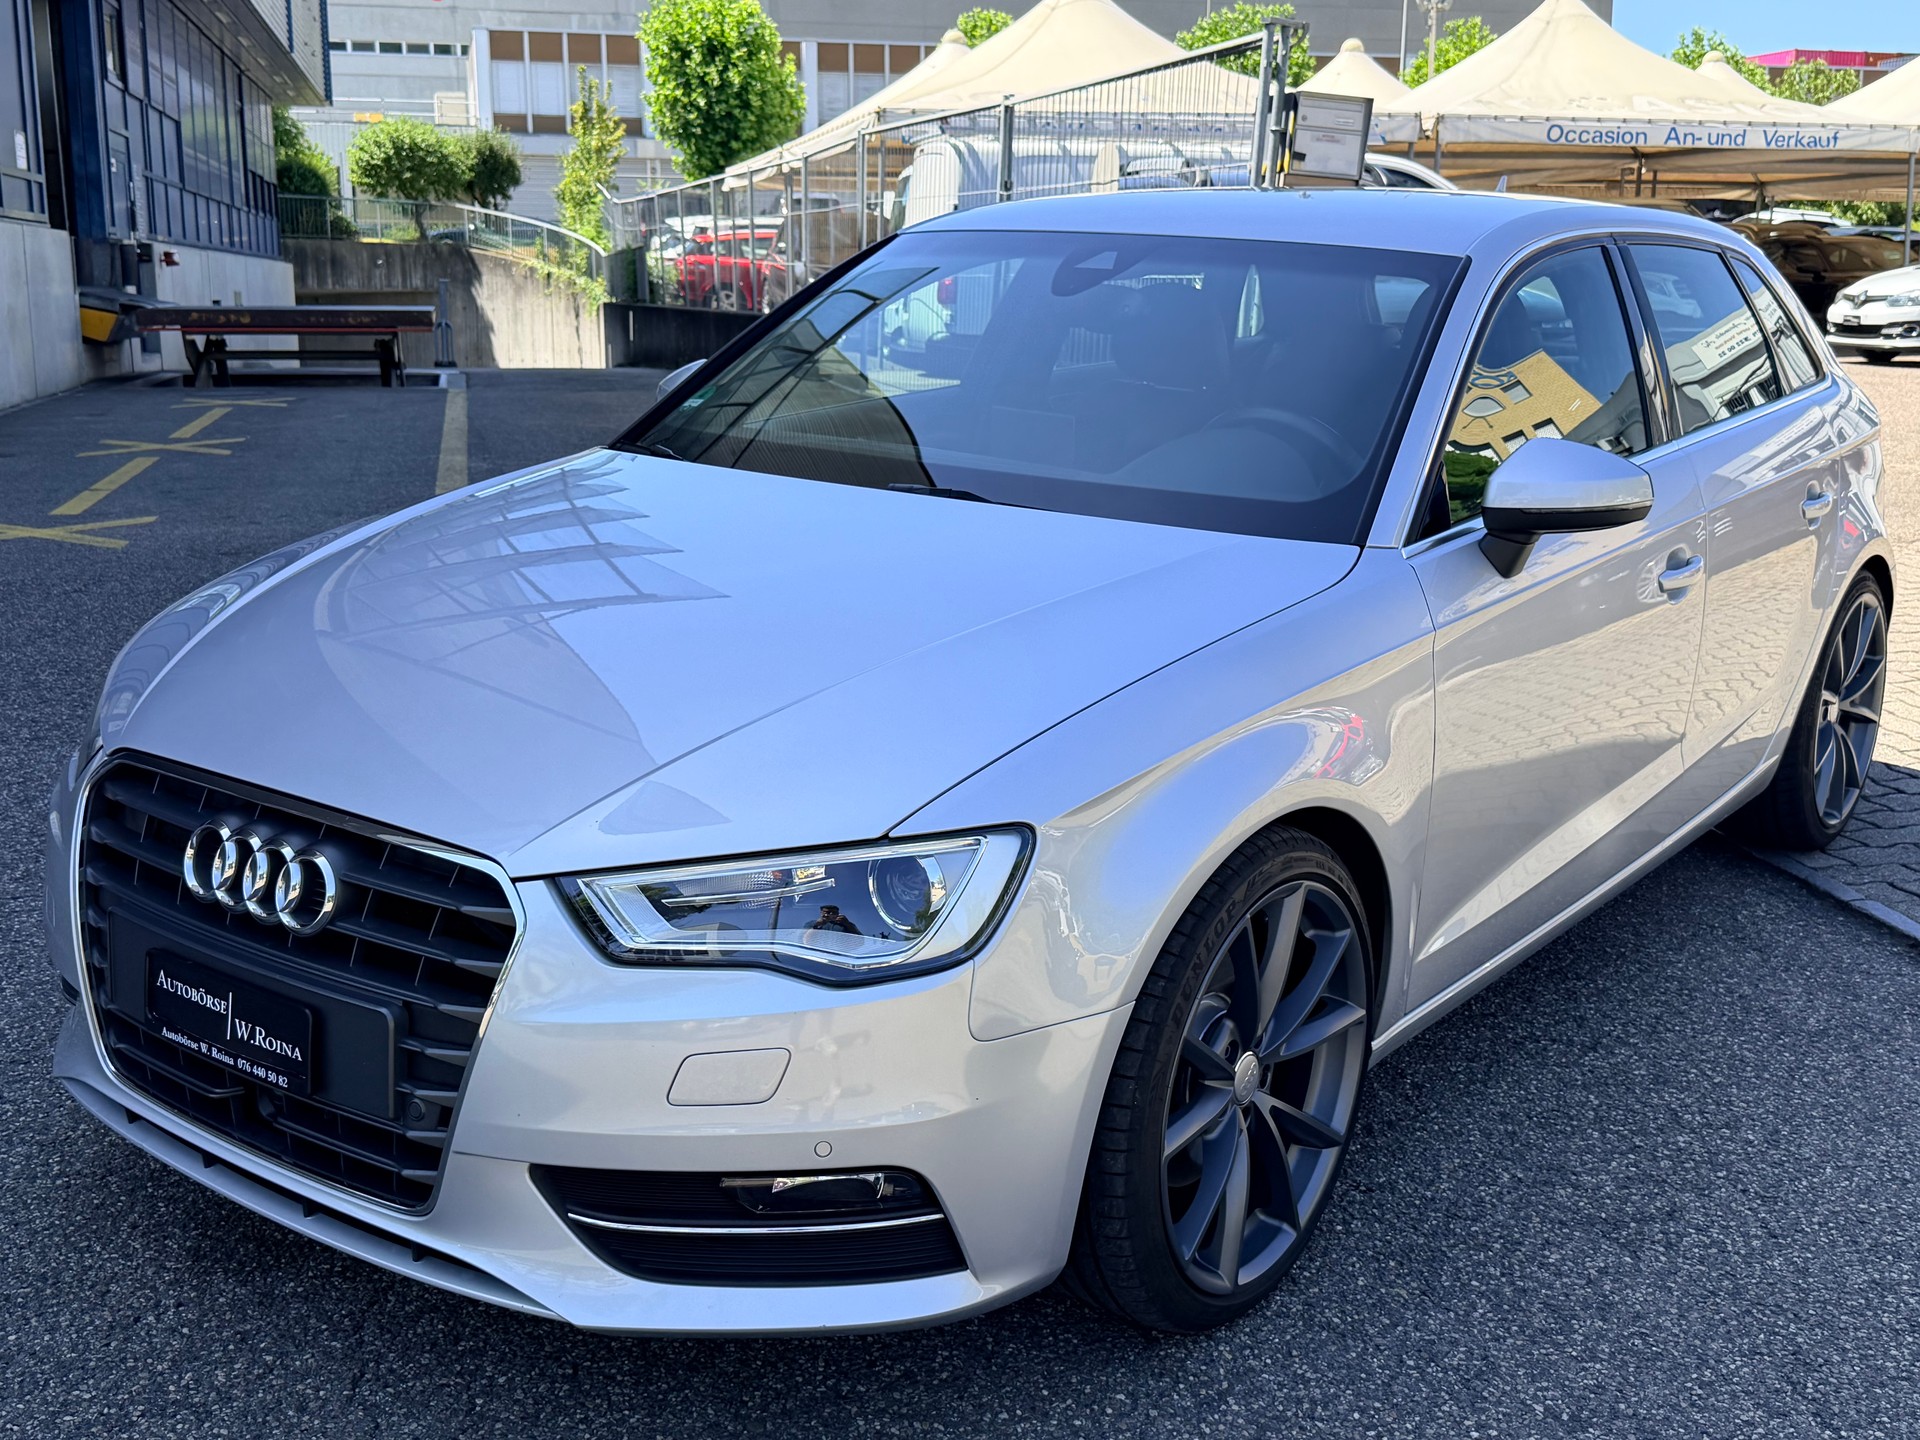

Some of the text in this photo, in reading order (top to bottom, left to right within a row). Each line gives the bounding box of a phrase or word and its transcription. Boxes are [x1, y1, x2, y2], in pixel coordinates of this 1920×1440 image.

[1545, 123, 1648, 145] Occasion
[1763, 130, 1840, 149] Verkauf
[1171, 898, 1241, 1026] DUNLOP
[161, 1026, 288, 1088] Autobörse W. Roina 076 440 50 82
